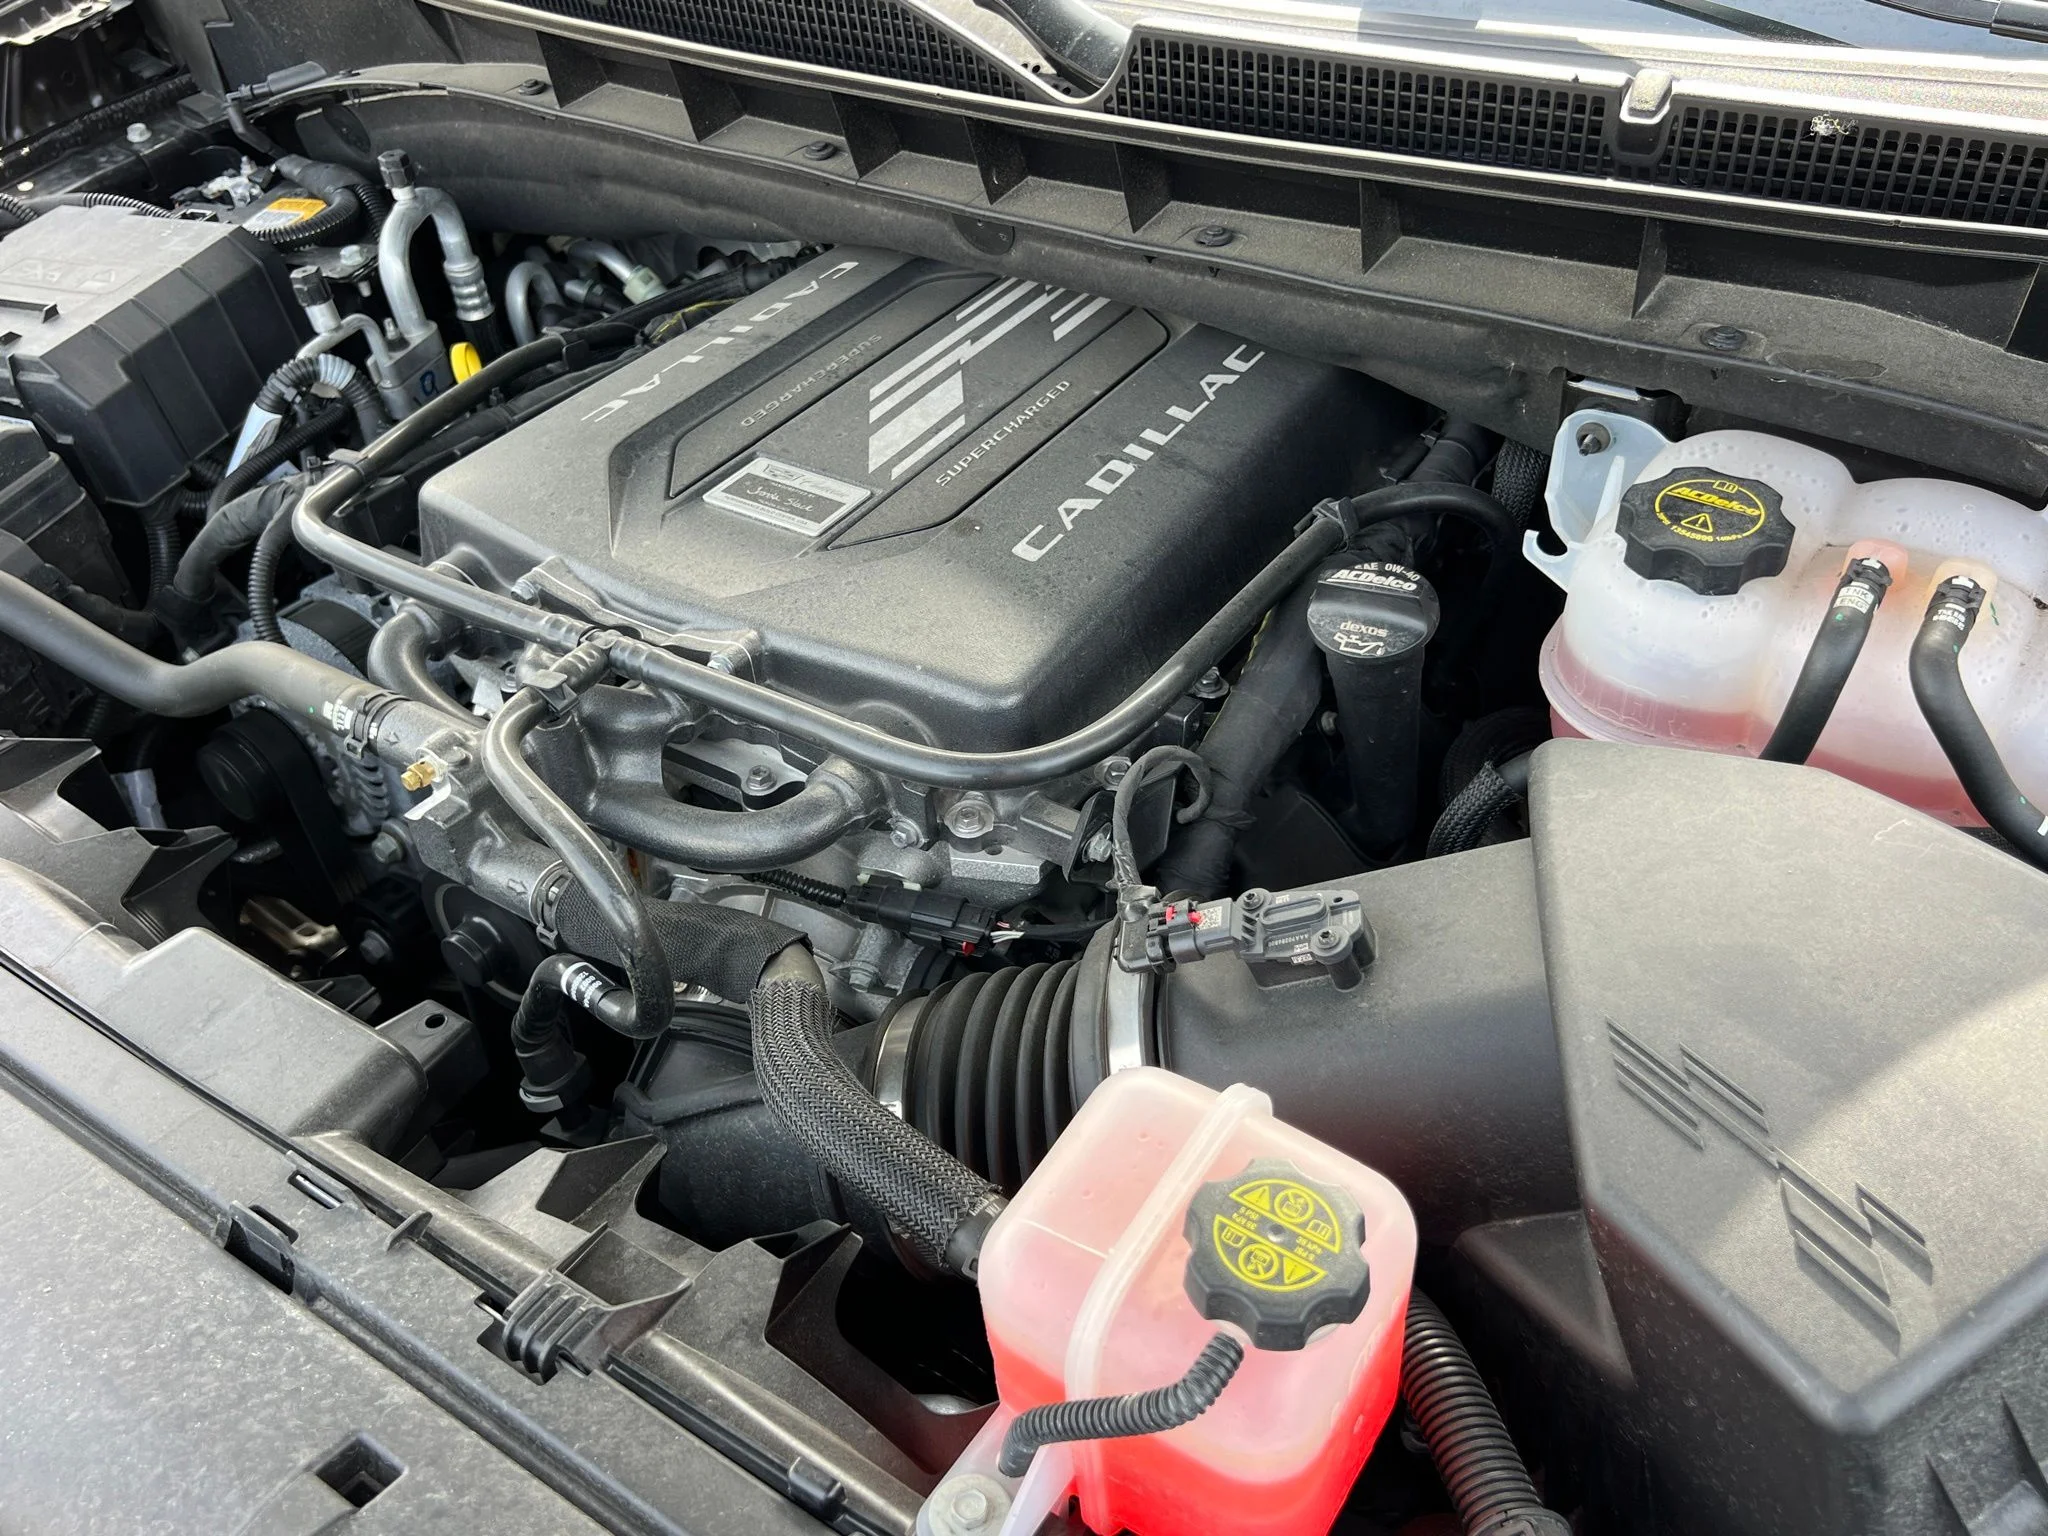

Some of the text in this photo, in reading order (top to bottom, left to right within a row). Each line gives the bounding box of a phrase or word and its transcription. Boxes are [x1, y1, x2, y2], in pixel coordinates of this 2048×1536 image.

[581, 262, 859, 422] CADILLAC
[740, 334, 882, 427] SUPERCHARGED
[935, 379, 1071, 487] SUPERCHARGED
[1011, 344, 1266, 562] CADILLAC
[1672, 487, 1760, 517] ACDelco
[1331, 569, 1418, 591] ACDelco
[1384, 563, 1421, 582] 0W-40
[1340, 621, 1389, 638] dexos
